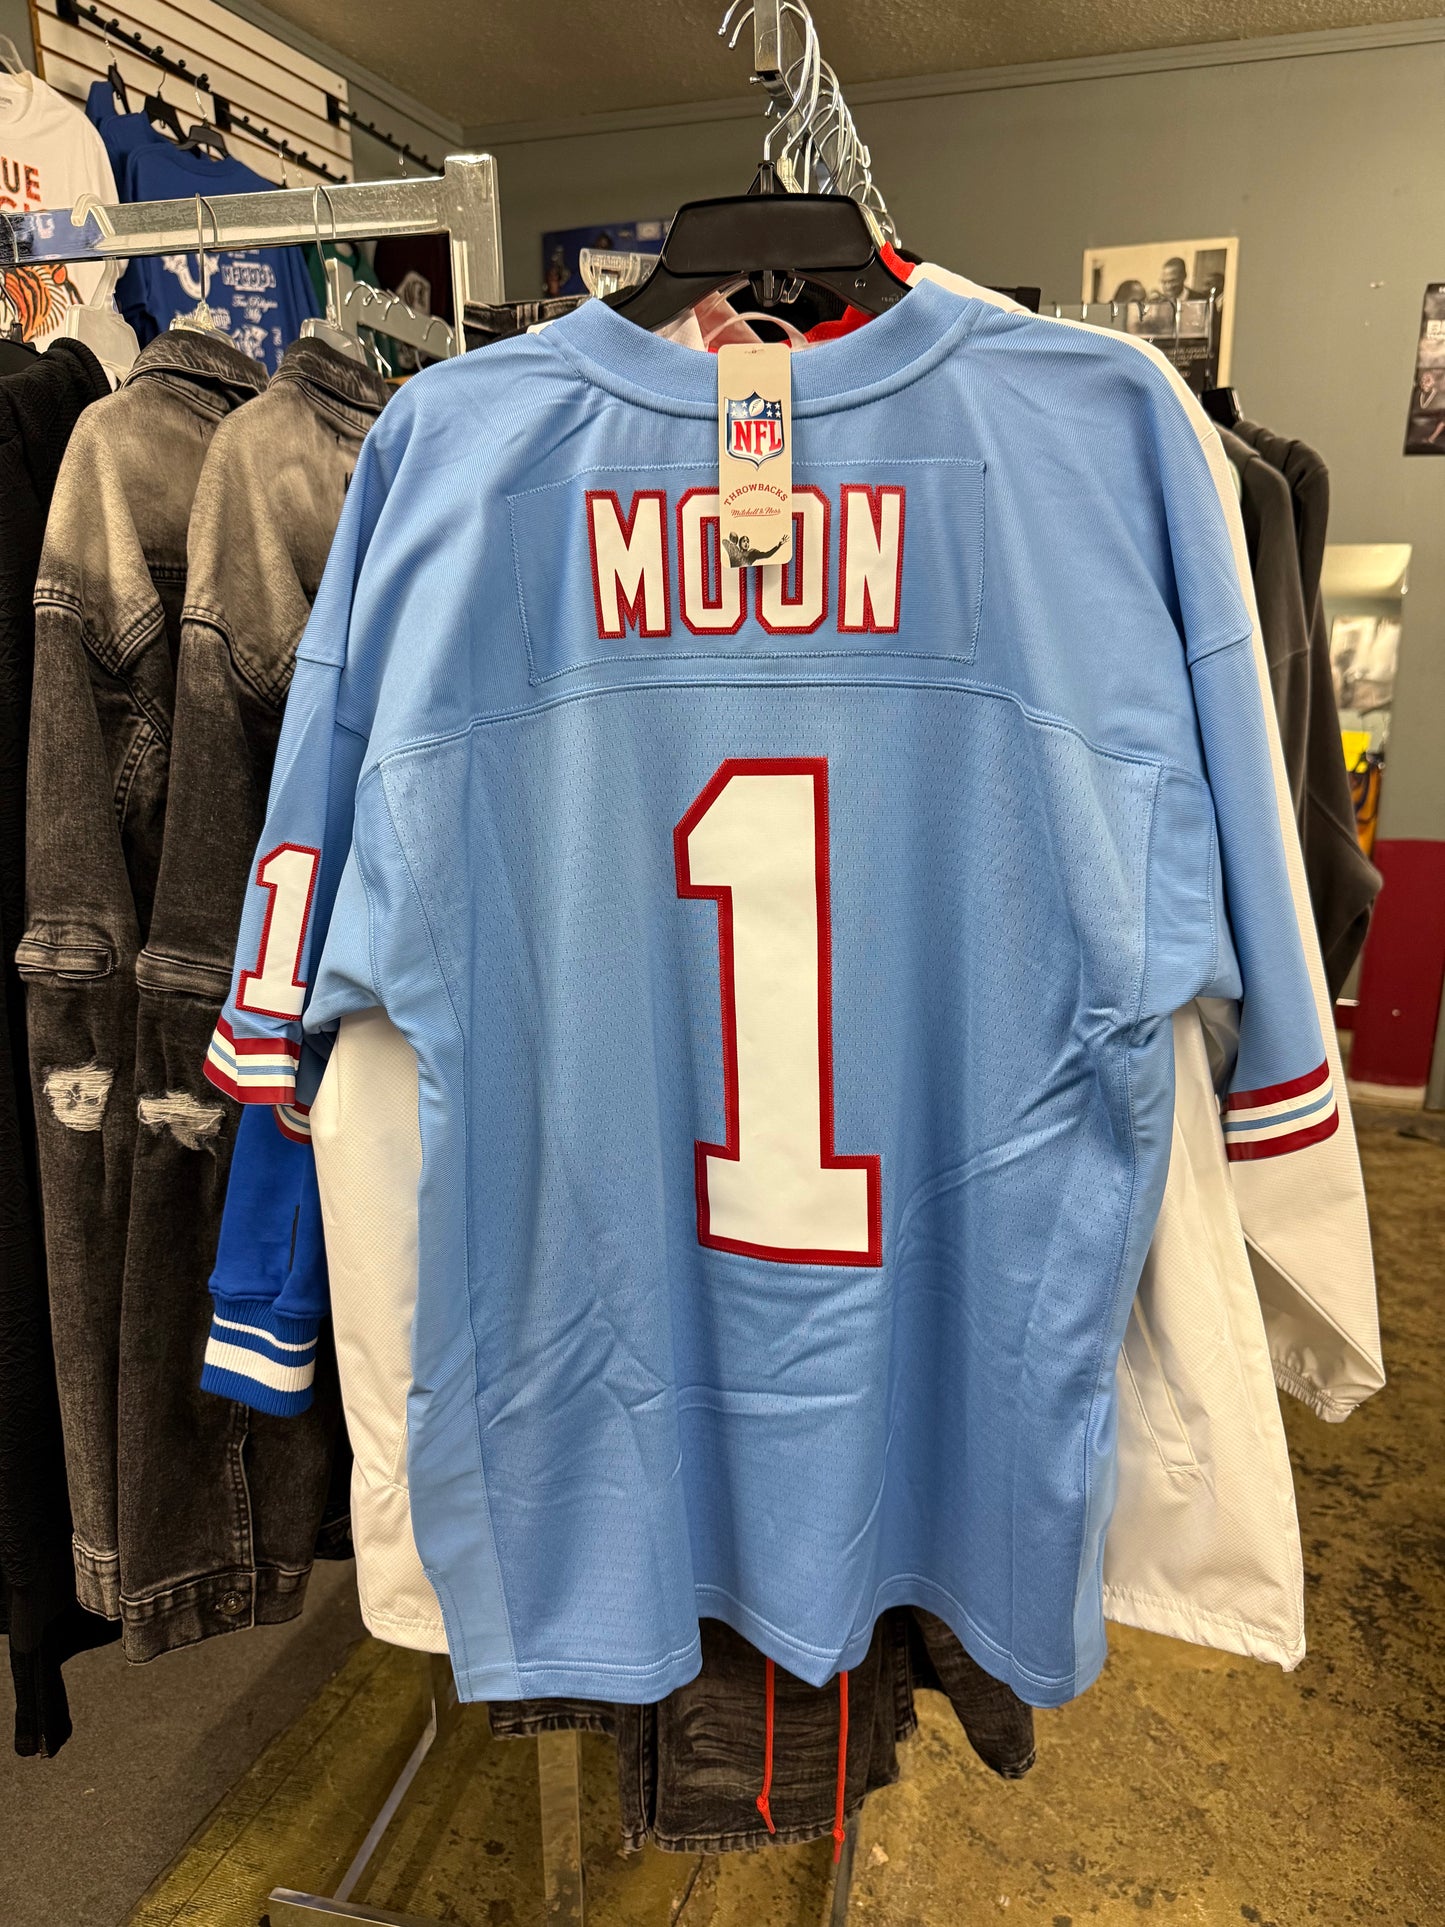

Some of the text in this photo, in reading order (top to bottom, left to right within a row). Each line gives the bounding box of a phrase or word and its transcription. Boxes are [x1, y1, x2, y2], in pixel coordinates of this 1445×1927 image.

[0, 155, 42, 203] UE
[733, 420, 782, 455] NFL
[723, 483, 788, 506] THROWBACKS
[730, 508, 759, 518] Mitchell
[585, 483, 906, 639] MOON
[235, 842, 321, 1022] 1
[673, 757, 883, 1267] 1
